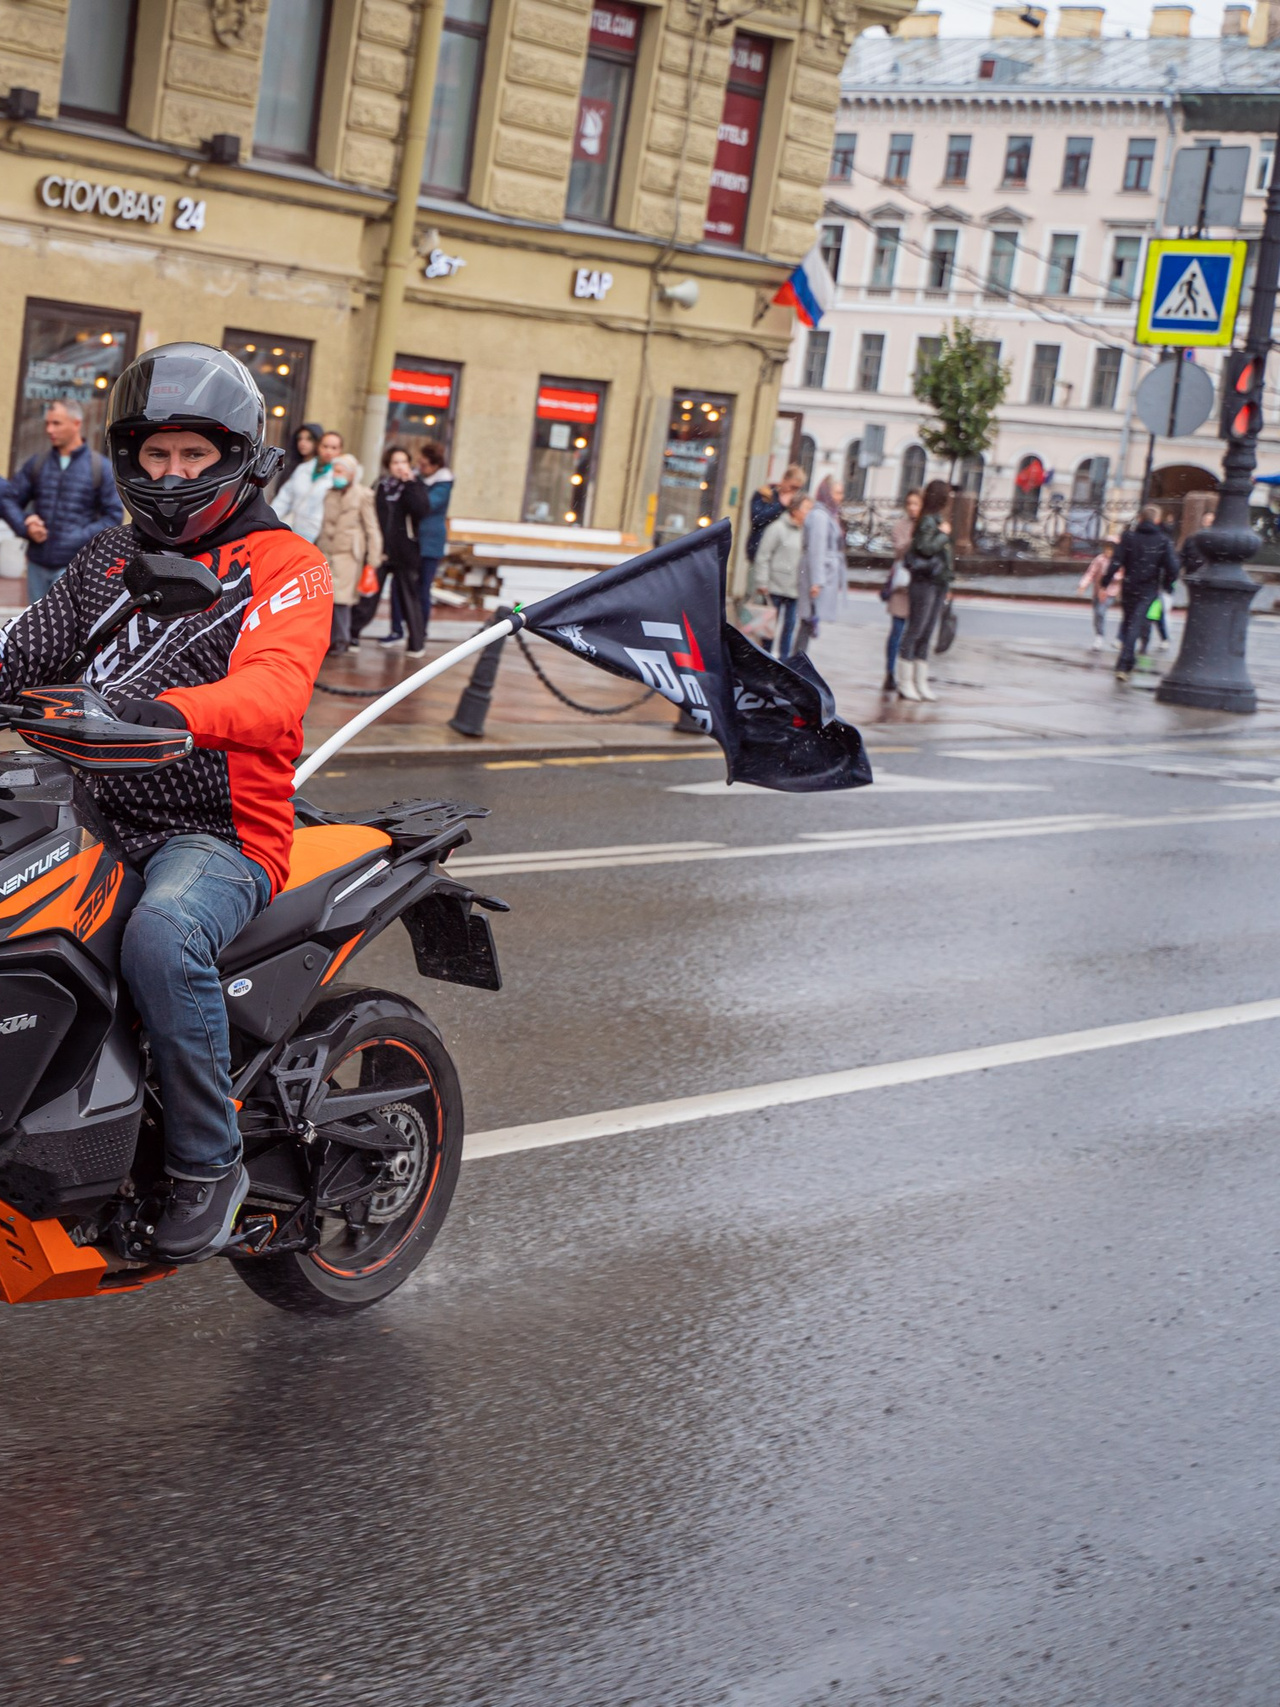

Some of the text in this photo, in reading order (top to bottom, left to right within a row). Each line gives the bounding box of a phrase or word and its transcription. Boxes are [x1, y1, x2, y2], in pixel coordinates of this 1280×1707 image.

[41, 174, 207, 232] СТОЛОВАЯ 24
[574, 267, 614, 301] БАР
[152, 386, 182, 395] BELL
[73, 863, 119, 939] 1290
[233, 985, 249, 995] MOTO
